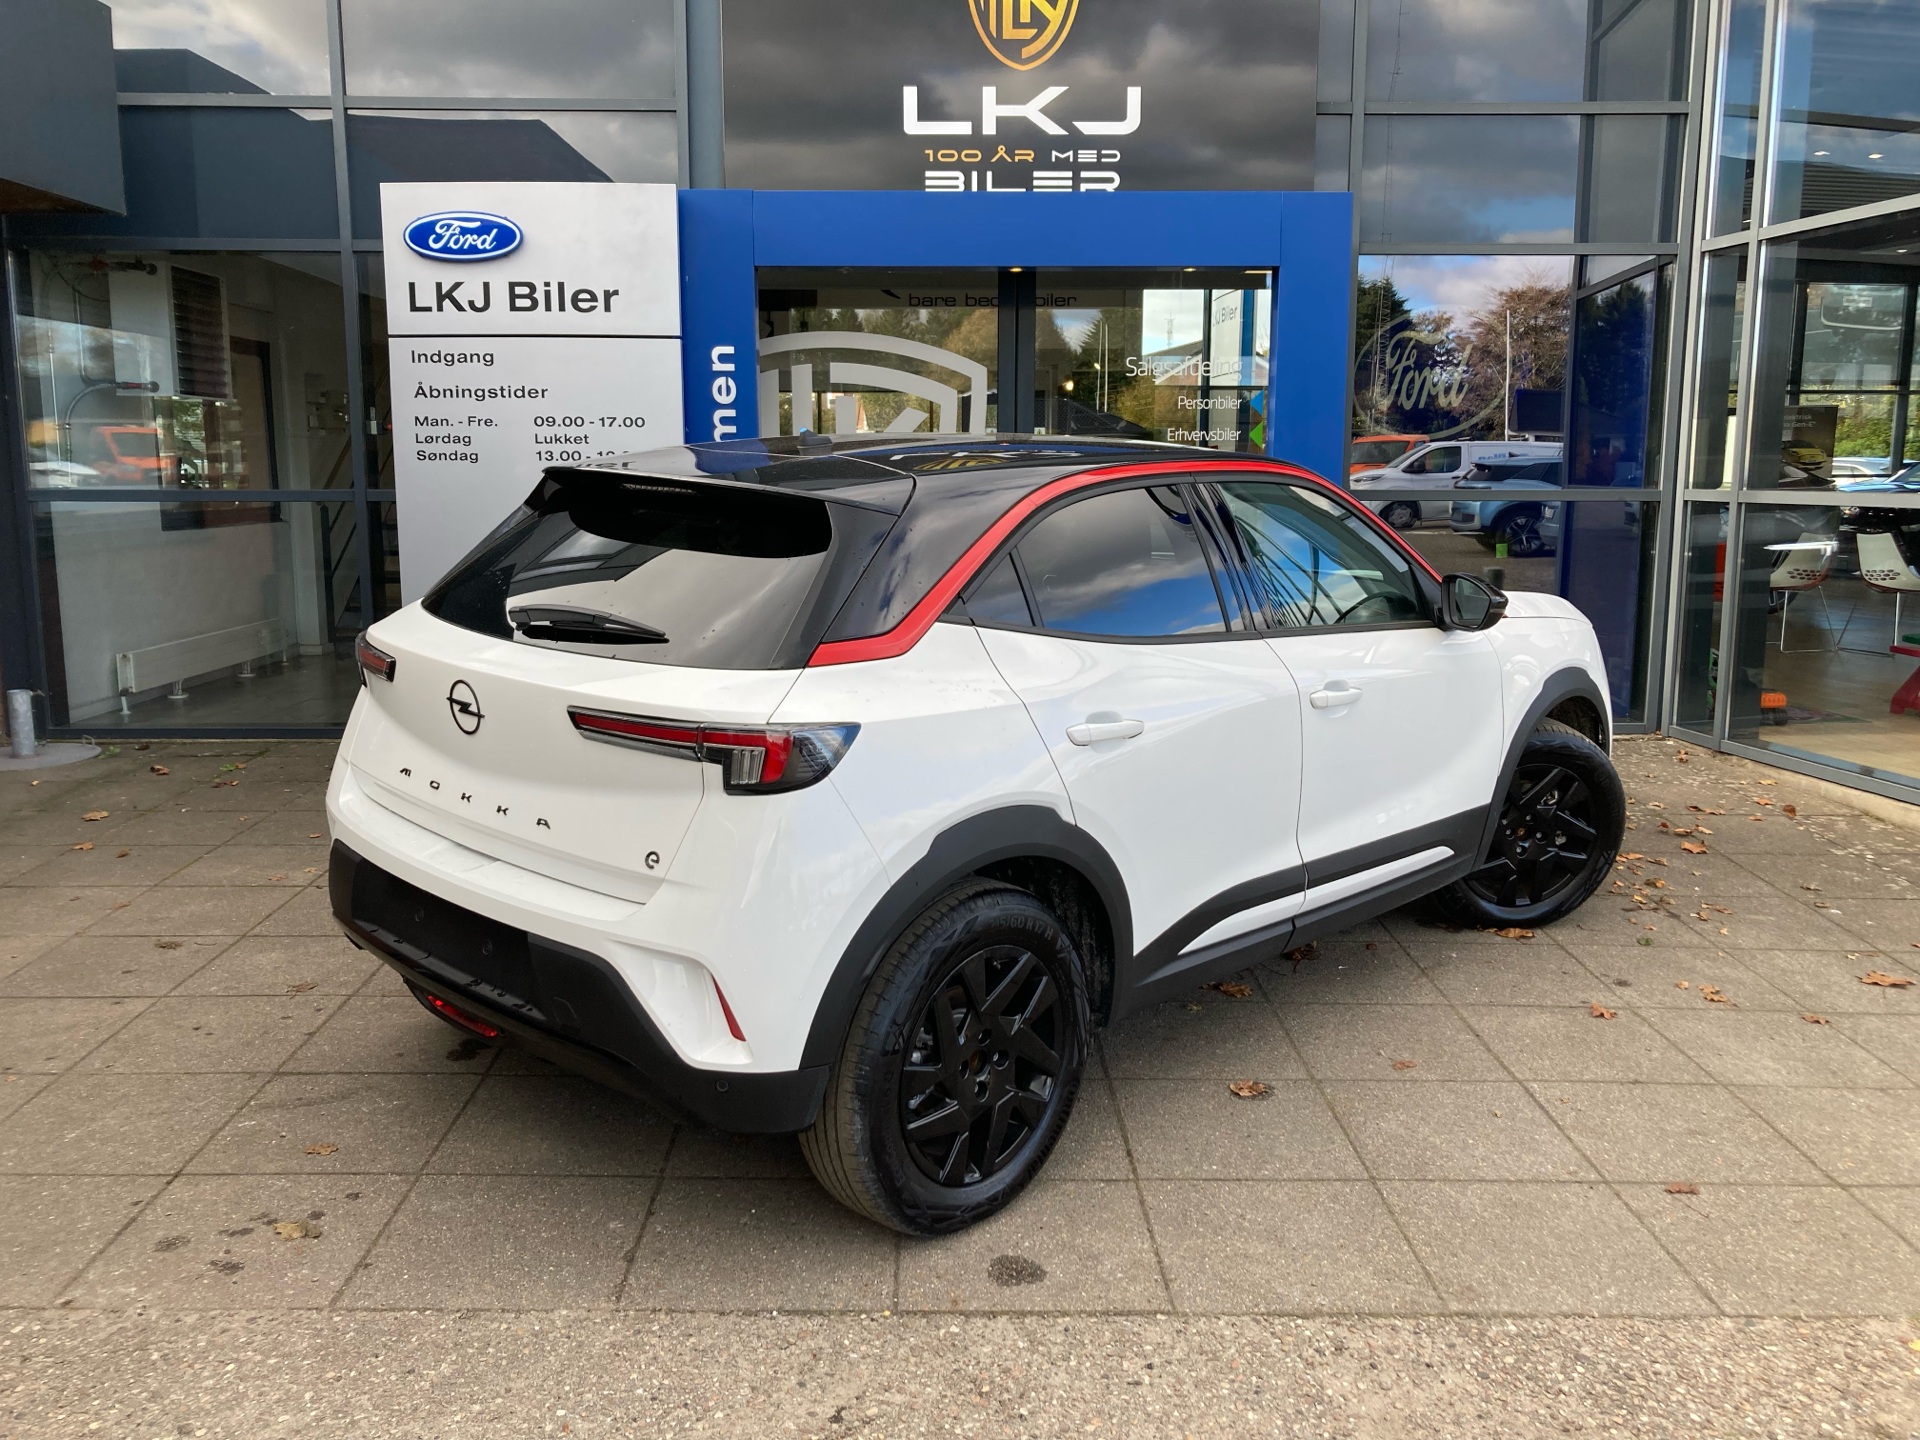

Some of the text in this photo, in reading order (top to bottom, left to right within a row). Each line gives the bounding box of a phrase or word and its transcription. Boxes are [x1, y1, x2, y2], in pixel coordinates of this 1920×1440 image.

[903, 86, 1142, 135] LKJ
[925, 145, 1121, 162] 100 ÅR MED
[924, 170, 1121, 191] BILER
[408, 281, 620, 313] LKJ Biler
[908, 293, 957, 307] bare
[411, 349, 495, 368] Indgang
[1125, 356, 1244, 382] Salgsafdeling
[1377, 330, 1474, 411] Ford
[414, 381, 549, 402] Åbningstider
[1177, 395, 1243, 410] Personbiler
[414, 415, 454, 427] Man.
[467, 415, 498, 427] Fre.
[533, 415, 585, 428] 09.00
[598, 415, 646, 428] 17.00
[415, 432, 590, 446] Lørdag Lukket
[1167, 427, 1242, 441] Erhvervsbiler
[416, 449, 479, 463] Søndag
[535, 450, 582, 462] 13.00
[399, 767, 551, 829] MOKKA
